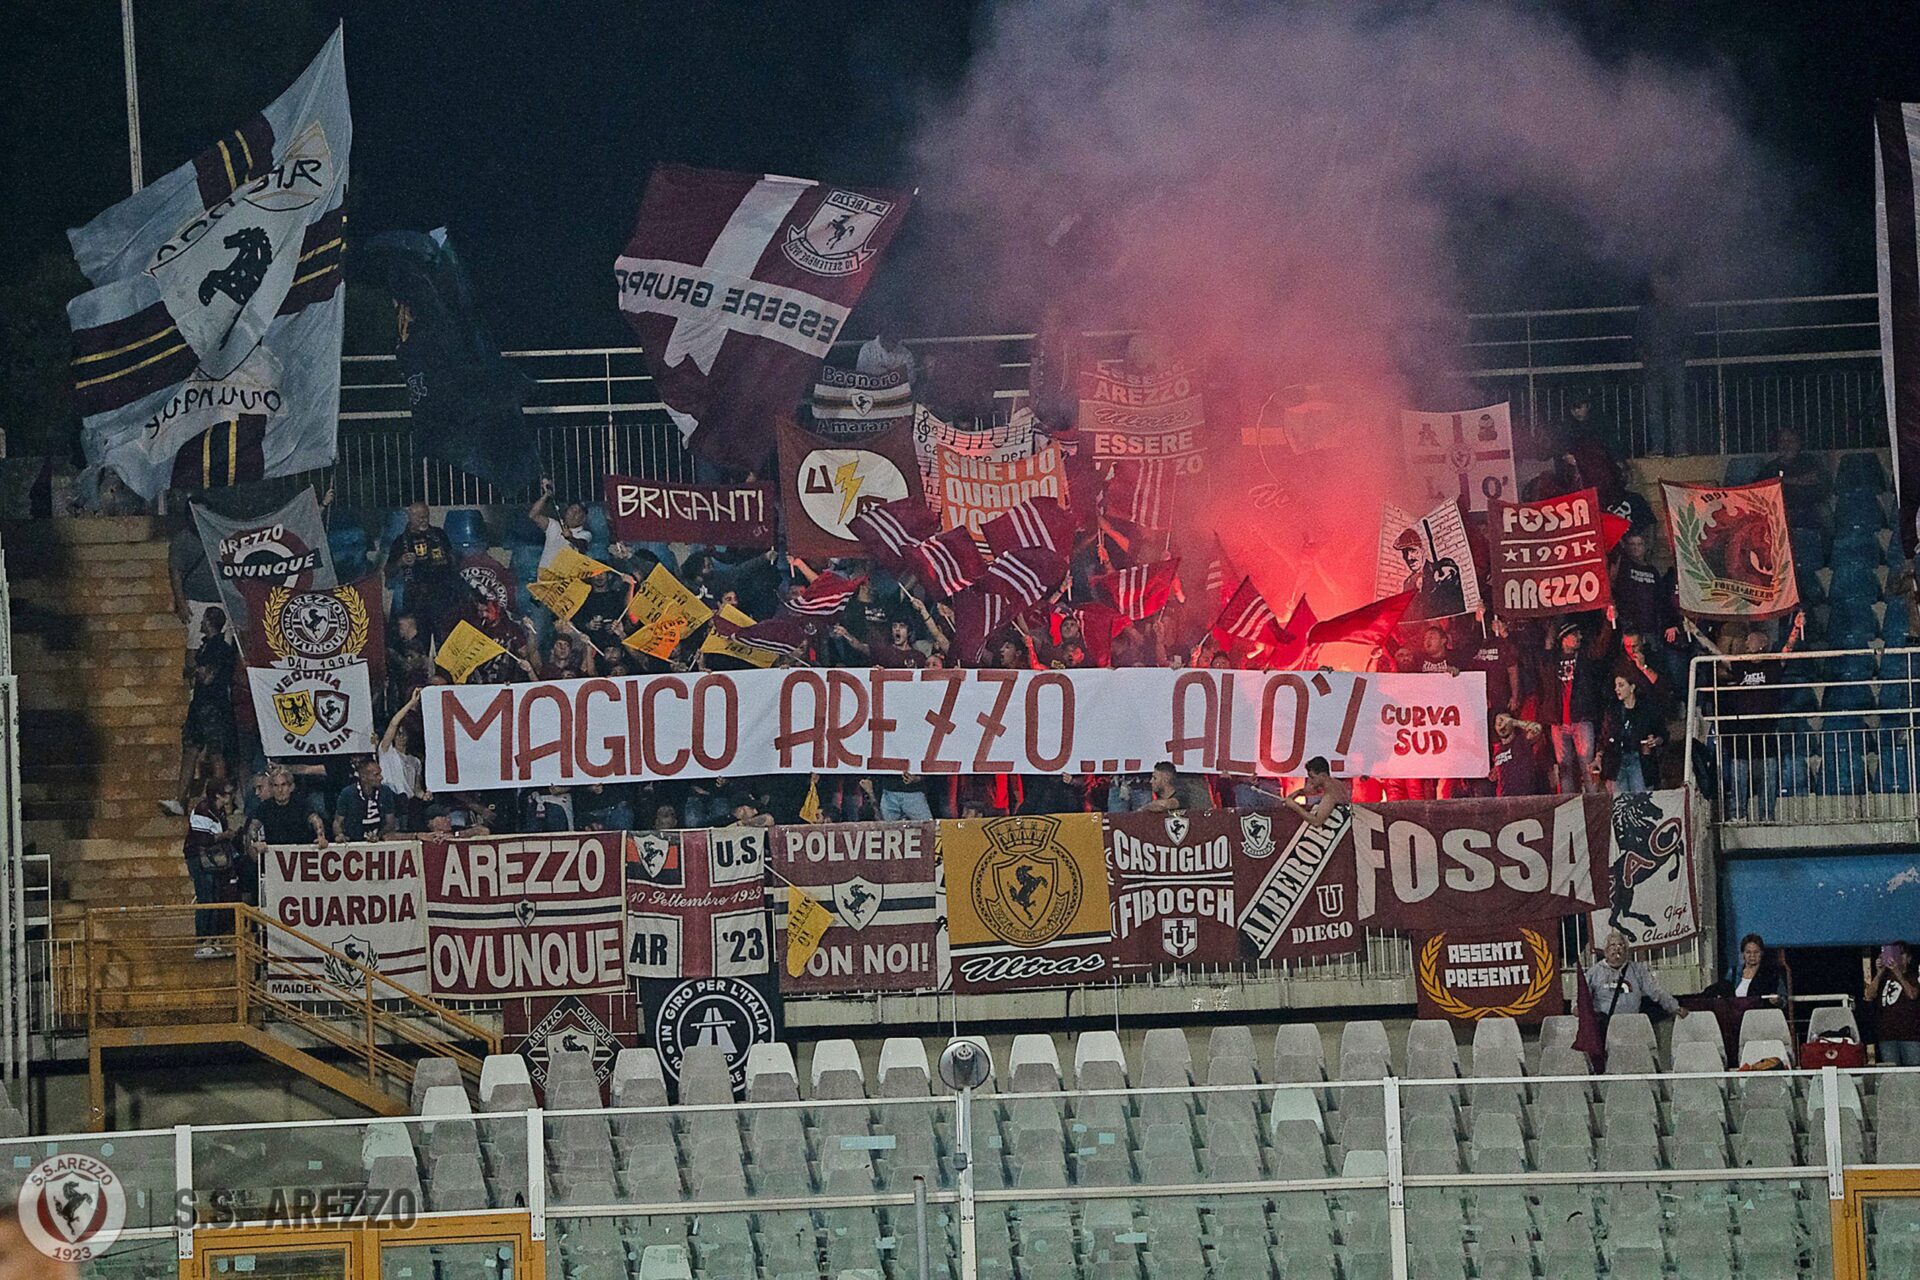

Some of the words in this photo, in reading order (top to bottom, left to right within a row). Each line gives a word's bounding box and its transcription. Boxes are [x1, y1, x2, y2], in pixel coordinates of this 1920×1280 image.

[823, 366, 899, 388] Bagnoro
[1094, 377, 1190, 405] AREZZO
[1095, 431, 1192, 454] ESSERE
[616, 484, 765, 523] BRIGANTI
[1503, 499, 1590, 533] FOSSA
[219, 523, 284, 556] AREZZO
[1521, 541, 1582, 563] 1991
[223, 553, 316, 578] OVUNQUE
[289, 595, 342, 614] AREZZO
[1504, 571, 1600, 609] AREZZO
[286, 629, 346, 653] OVUNQUE
[288, 656, 308, 669] DAI
[320, 655, 354, 668] 1994
[273, 670, 341, 694] VECCHIA
[441, 673, 738, 784] MAGICO
[1381, 703, 1461, 728] CURVA
[1394, 729, 1448, 756] SUD
[786, 829, 922, 863] POLVERE
[1114, 828, 1233, 872] CASTIGLIO
[1351, 794, 1597, 921] FOSSA
[276, 850, 417, 882] VECCHIA
[441, 838, 606, 898] AREZZO
[1240, 804, 1345, 952] ALBERORO
[278, 893, 417, 927] GUARDIA
[630, 892, 645, 904] 10
[648, 888, 728, 909] Settembre
[731, 886, 762, 904] 1923
[1664, 903, 1687, 921] Gigi
[723, 929, 764, 963] '23
[1291, 921, 1354, 945] DIEGO
[1642, 923, 1692, 942] Claudio
[433, 929, 624, 989] OVUNQUE
[629, 932, 669, 967] AR
[863, 942, 929, 975] NOI!
[1448, 942, 1524, 964] ASSENTI
[960, 953, 1105, 983] Ultras
[1445, 965, 1531, 989] PRESENTI
[696, 979, 727, 993] PER
[665, 987, 693, 1020] GIRO
[729, 983, 769, 1035] L'ITALIA
[528, 1009, 563, 1047] AREZZO
[577, 1006, 615, 1047] OVUNQUE
[661, 1025, 673, 1041] IN
